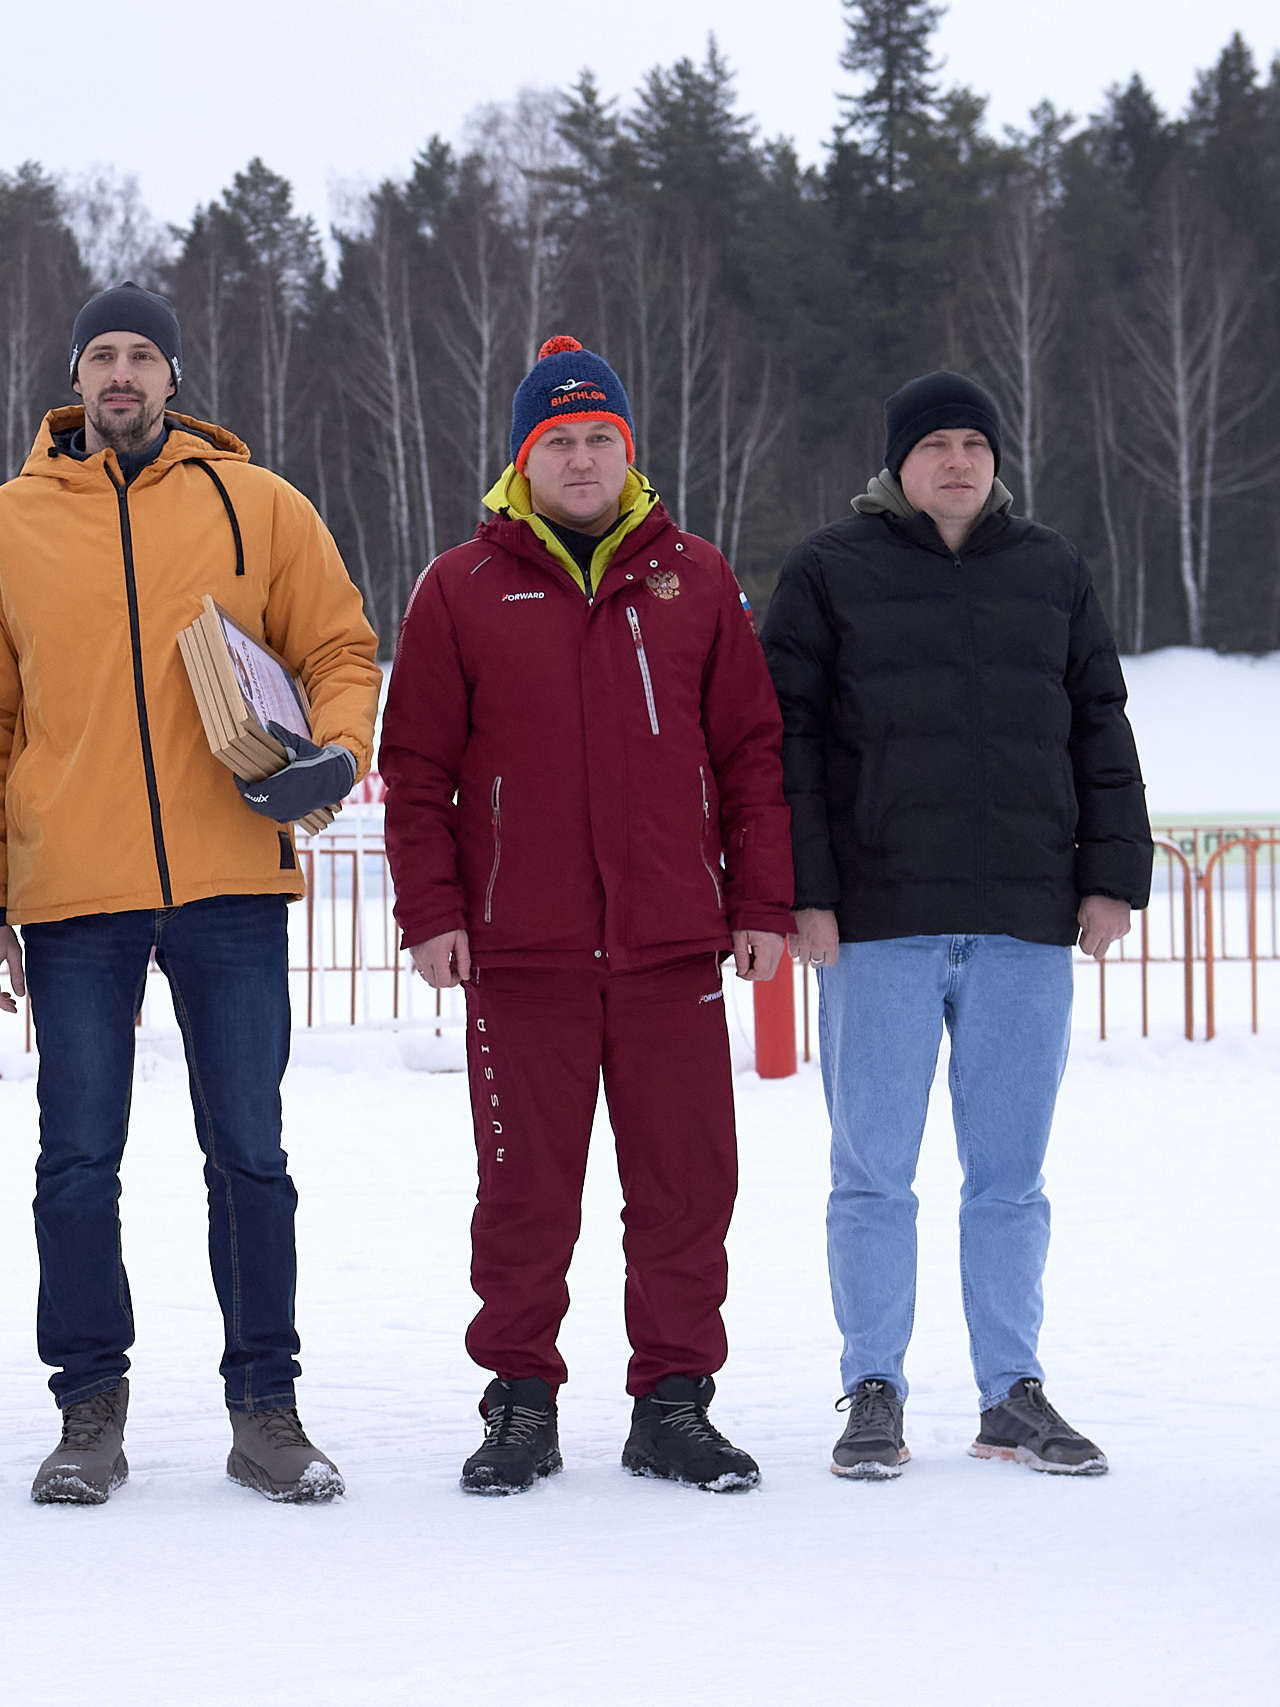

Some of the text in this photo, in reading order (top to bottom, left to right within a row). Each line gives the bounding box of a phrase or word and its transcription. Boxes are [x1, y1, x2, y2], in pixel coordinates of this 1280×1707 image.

[550, 390, 607, 407] BIATHLON
[501, 591, 545, 602] FORWARD
[476, 1018, 506, 1163] RUSSIA
